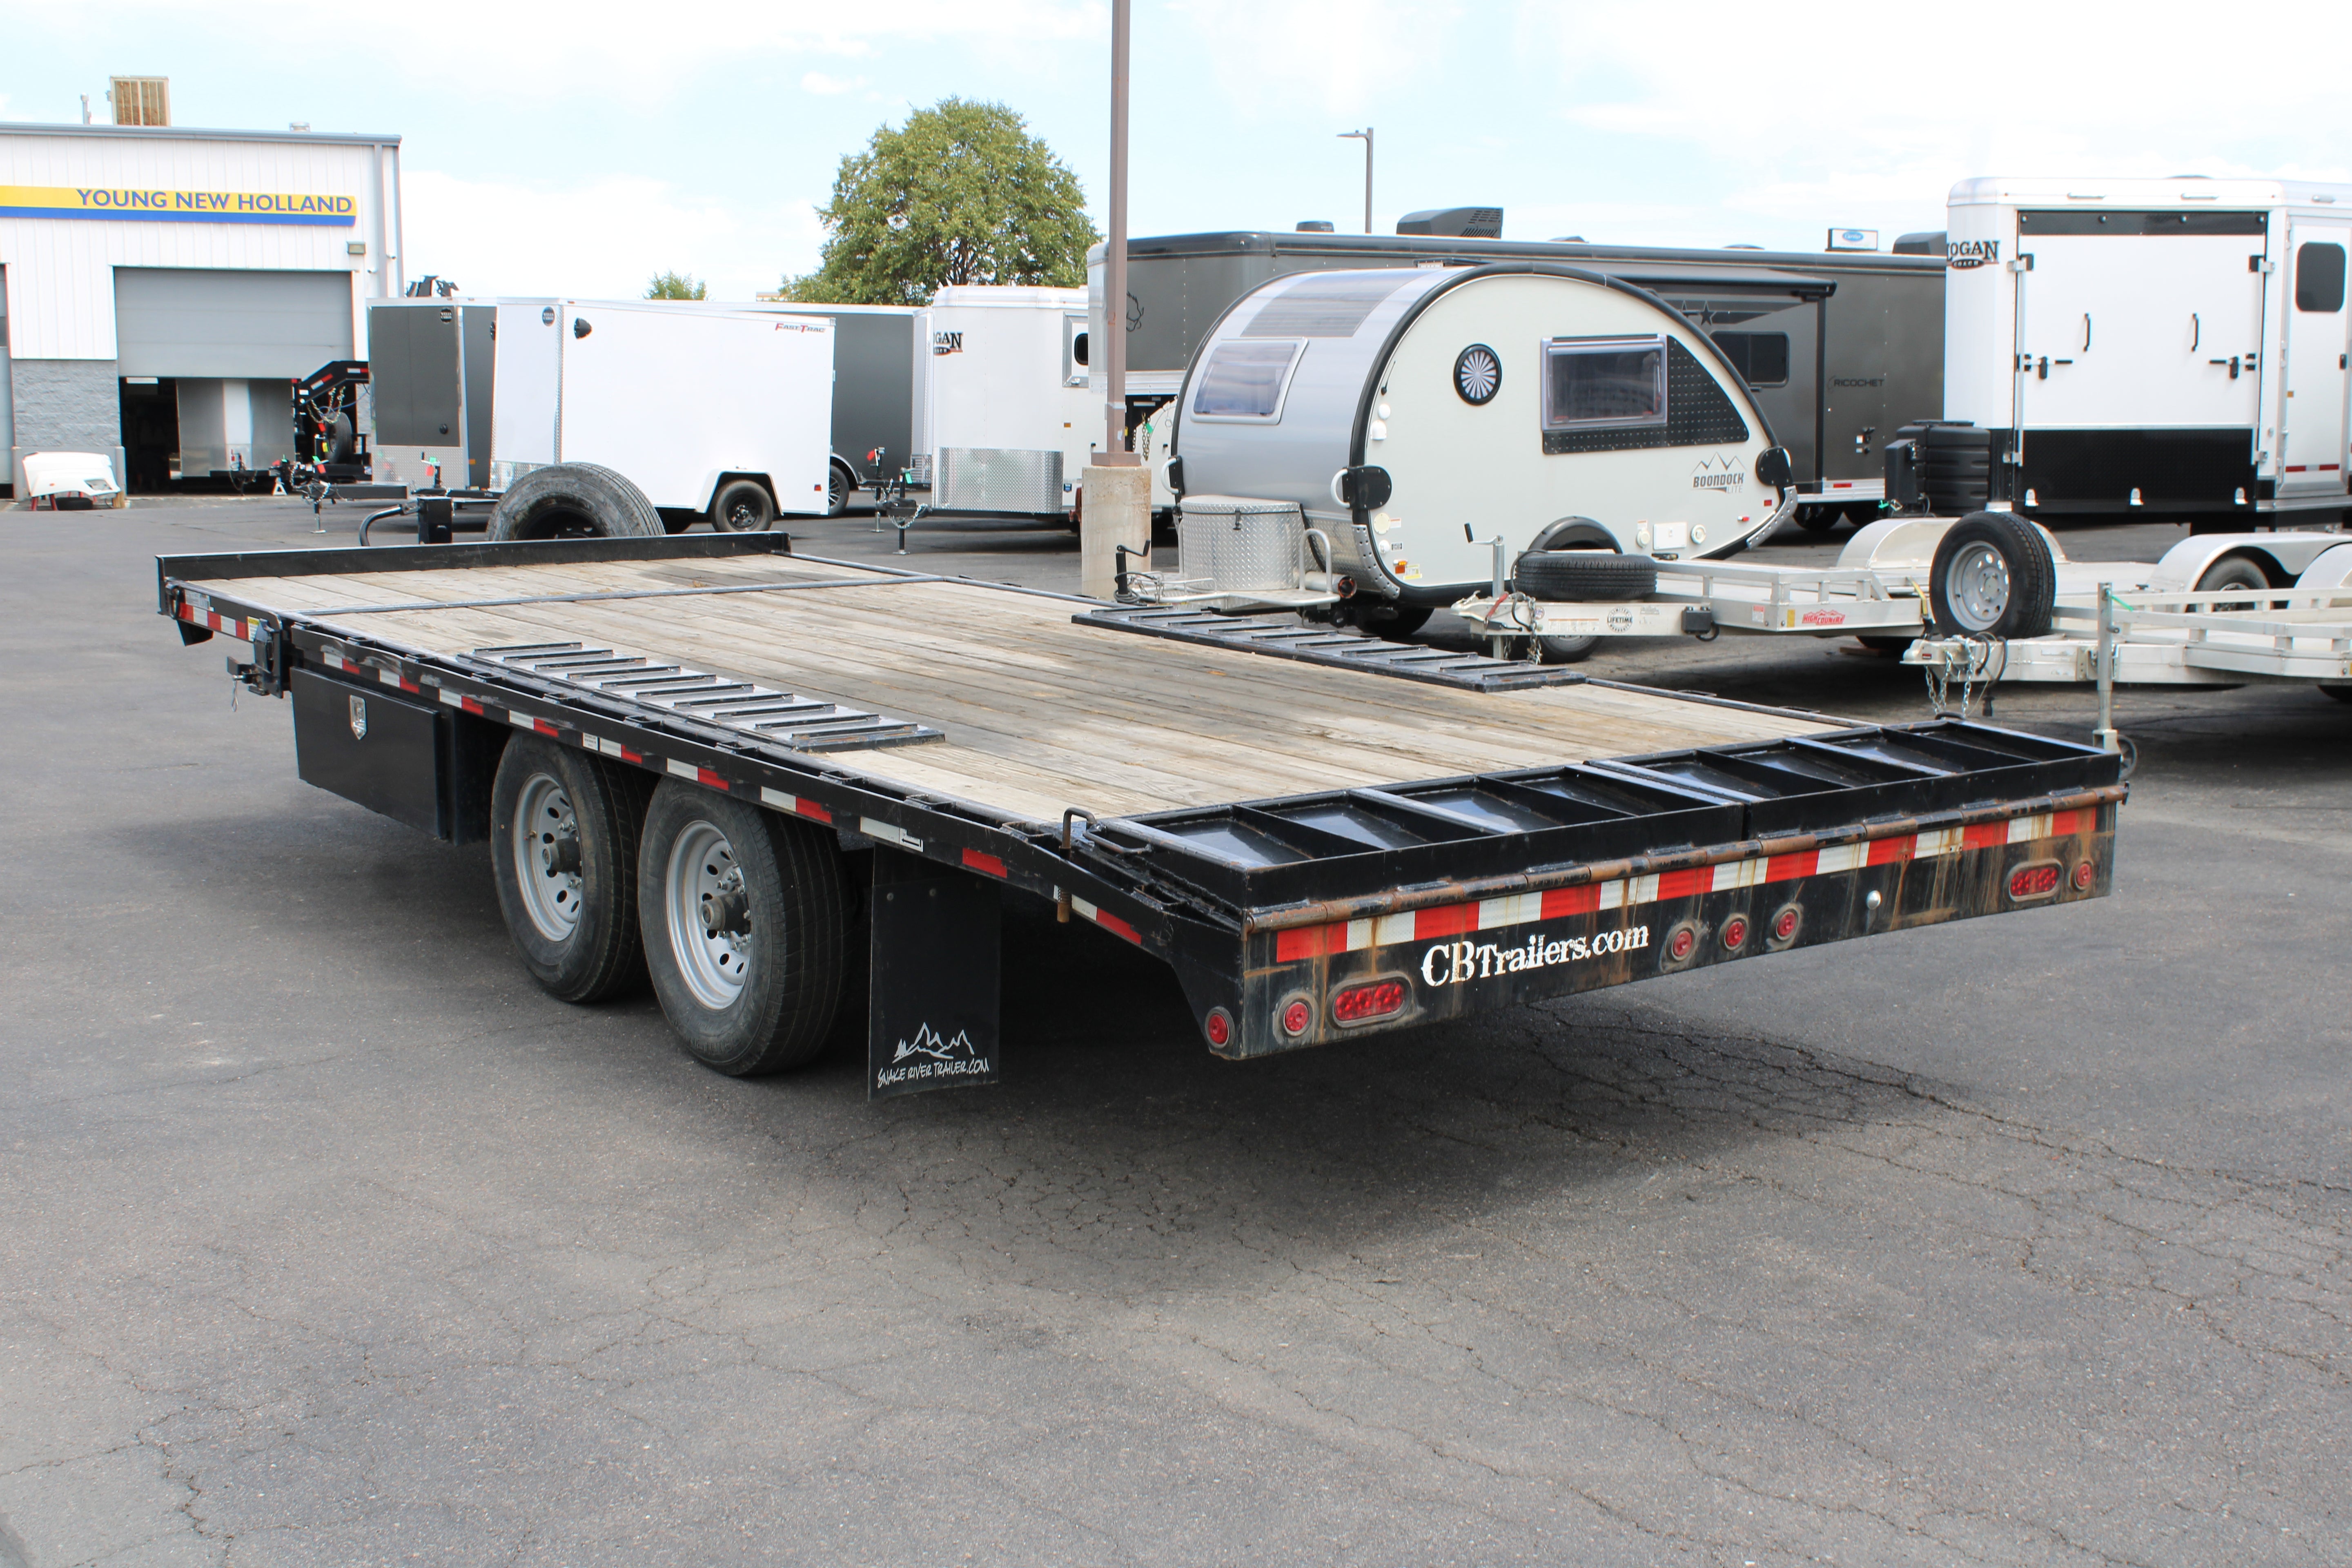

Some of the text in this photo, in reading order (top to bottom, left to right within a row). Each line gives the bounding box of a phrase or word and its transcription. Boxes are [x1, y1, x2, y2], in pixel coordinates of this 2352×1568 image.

[76, 189, 352, 212] YOUNG NEW HOLLAND
[933, 331, 963, 349] GAN
[1693, 473, 1744, 488] BOONDOCK
[1727, 485, 1742, 494] LITE
[1816, 616, 1844, 624] COUNTRY
[1421, 925, 1649, 987] CBTrailers.com
[878, 1057, 989, 1089] SNAKE RIVER TRAILER.COM
